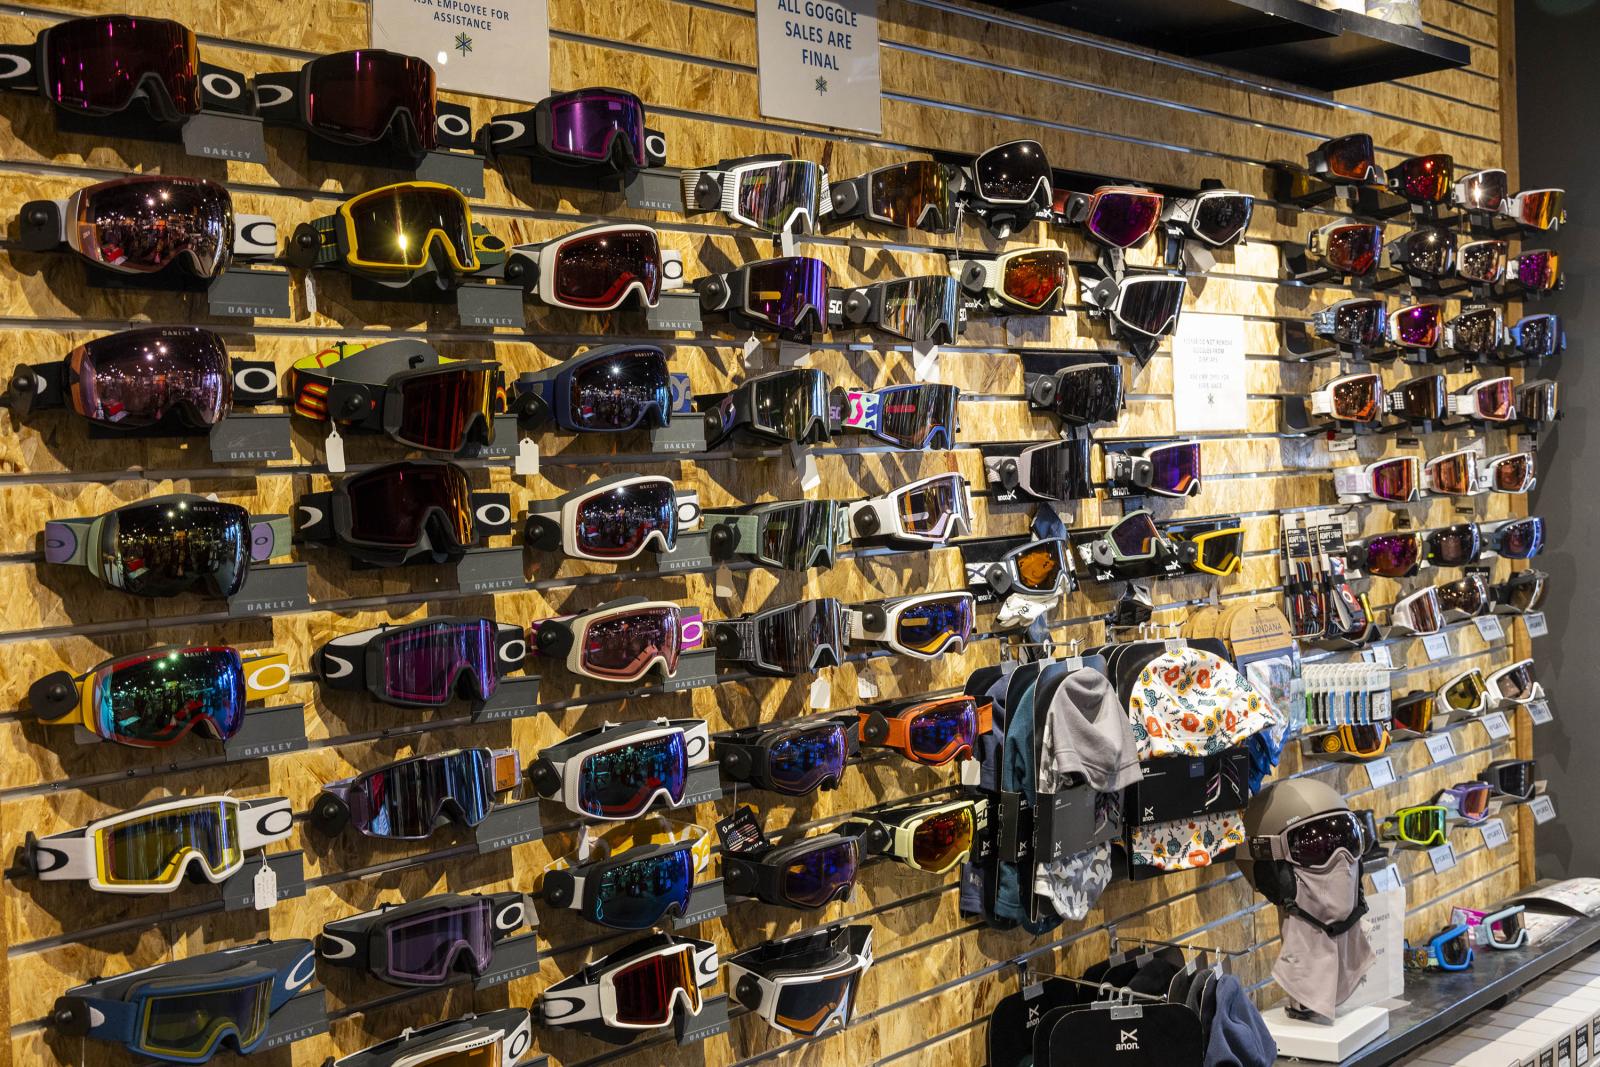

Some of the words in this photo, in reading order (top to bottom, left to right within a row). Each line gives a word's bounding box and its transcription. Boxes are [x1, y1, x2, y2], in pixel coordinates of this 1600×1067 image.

[437, 0, 487, 17] EMPLOYEE
[491, 9, 509, 21] FOR
[778, 0, 801, 14] ALL
[805, 1, 857, 27] GOGGLE
[433, 11, 492, 31] ASSISTANCE
[785, 20, 823, 44] SALES
[827, 31, 852, 50] ARE
[802, 48, 839, 71] FINAL
[203, 146, 251, 159] OAKLEY
[639, 200, 672, 209] OAKLEY
[228, 306, 275, 315] OAKLEY
[475, 317, 513, 325] OAKLEY
[659, 321, 692, 329] OAKLEY
[664, 442, 696, 450] OAKLEY
[230, 450, 277, 459] OAKLEY
[670, 560, 702, 569] OAKLEY
[474, 580, 513, 590] OAKLEY
[247, 599, 295, 611] OAKLEY
[675, 678, 708, 688] OAKLEY
[487, 708, 527, 719] OAKLEY
[244, 741, 293, 756] OAKLEY
[493, 832, 532, 848] OAKLEY
[685, 909, 718, 925] OAKLEY
[488, 967, 528, 984] OAKLEY
[268, 1027, 315, 1048] OAKLEY
[690, 1026, 722, 1041] OAKLEY
[1116, 1041, 1140, 1051] anon.
